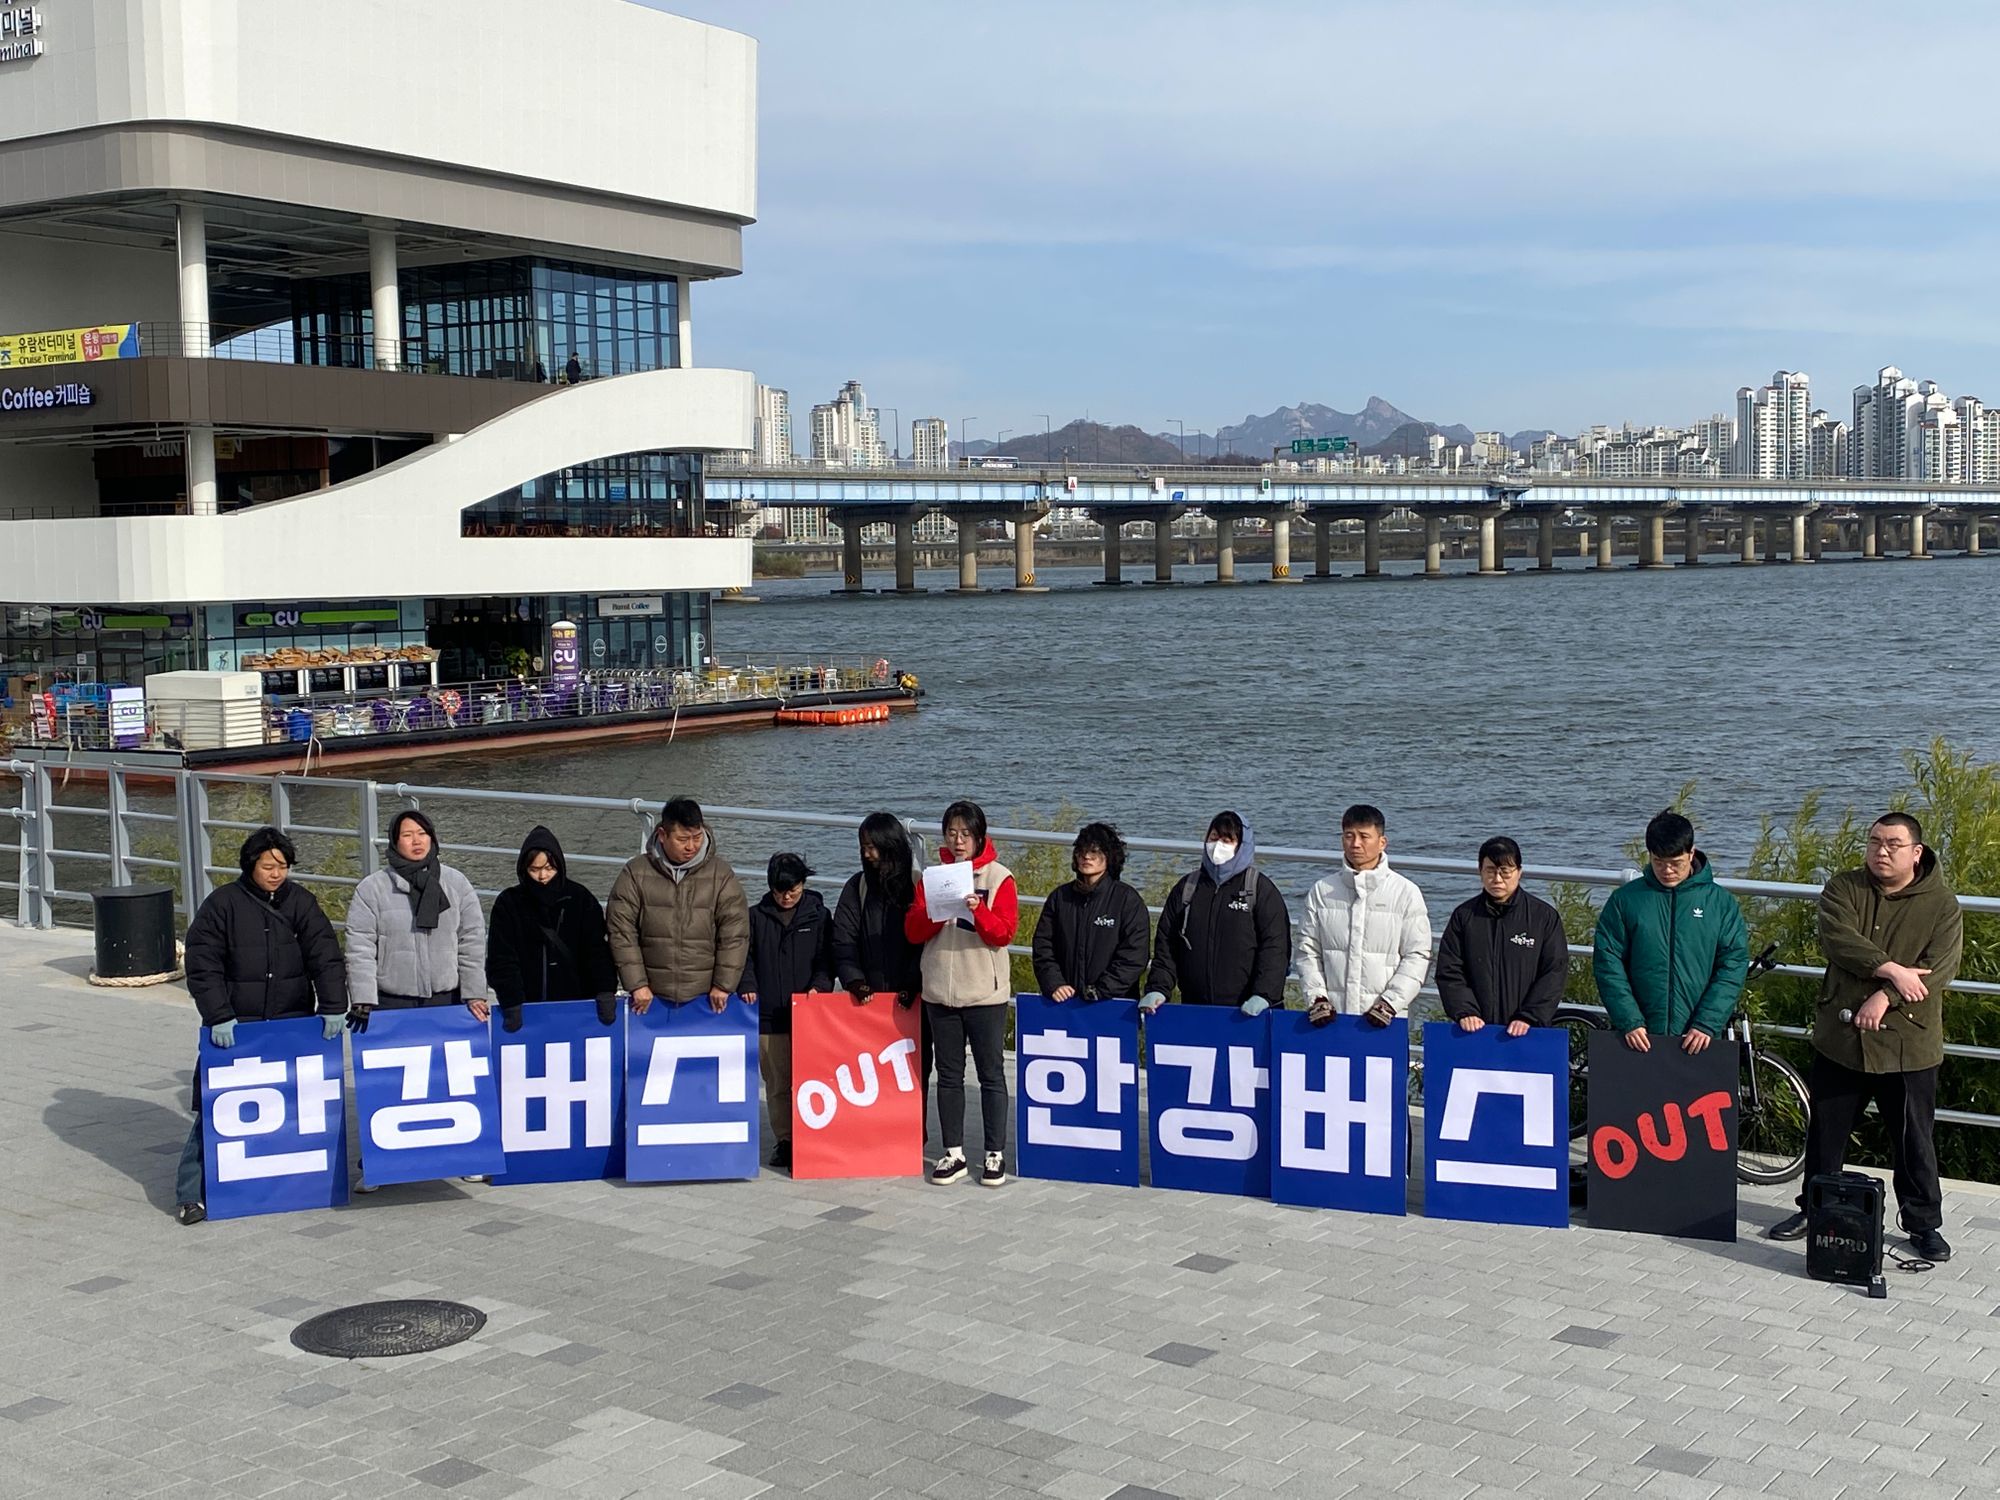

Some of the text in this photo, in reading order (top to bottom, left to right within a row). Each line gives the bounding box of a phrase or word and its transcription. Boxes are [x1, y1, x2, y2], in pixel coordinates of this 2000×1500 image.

[0, 6, 36, 38] 미널
[18, 333, 76, 353] 유람선터미널
[19, 350, 77, 365] Cruise Terminal
[2, 383, 91, 410] Coffee 커피숍
[142, 441, 181, 458] KIRIN
[82, 614, 102, 630] CU
[274, 611, 298, 626] CU
[553, 649, 576, 662] CU
[121, 707, 137, 716] CU
[208, 1054, 341, 1183] 한
[362, 1040, 489, 1150] 강
[501, 1036, 611, 1153] 버
[637, 1034, 749, 1146] 스
[797, 1038, 916, 1130] OUT
[1022, 1028, 1135, 1151] 한
[1153, 1044, 1270, 1161] 강
[1280, 1052, 1393, 1178] 버
[1436, 1067, 1557, 1190] 스
[1592, 1091, 1733, 1180] OUT
